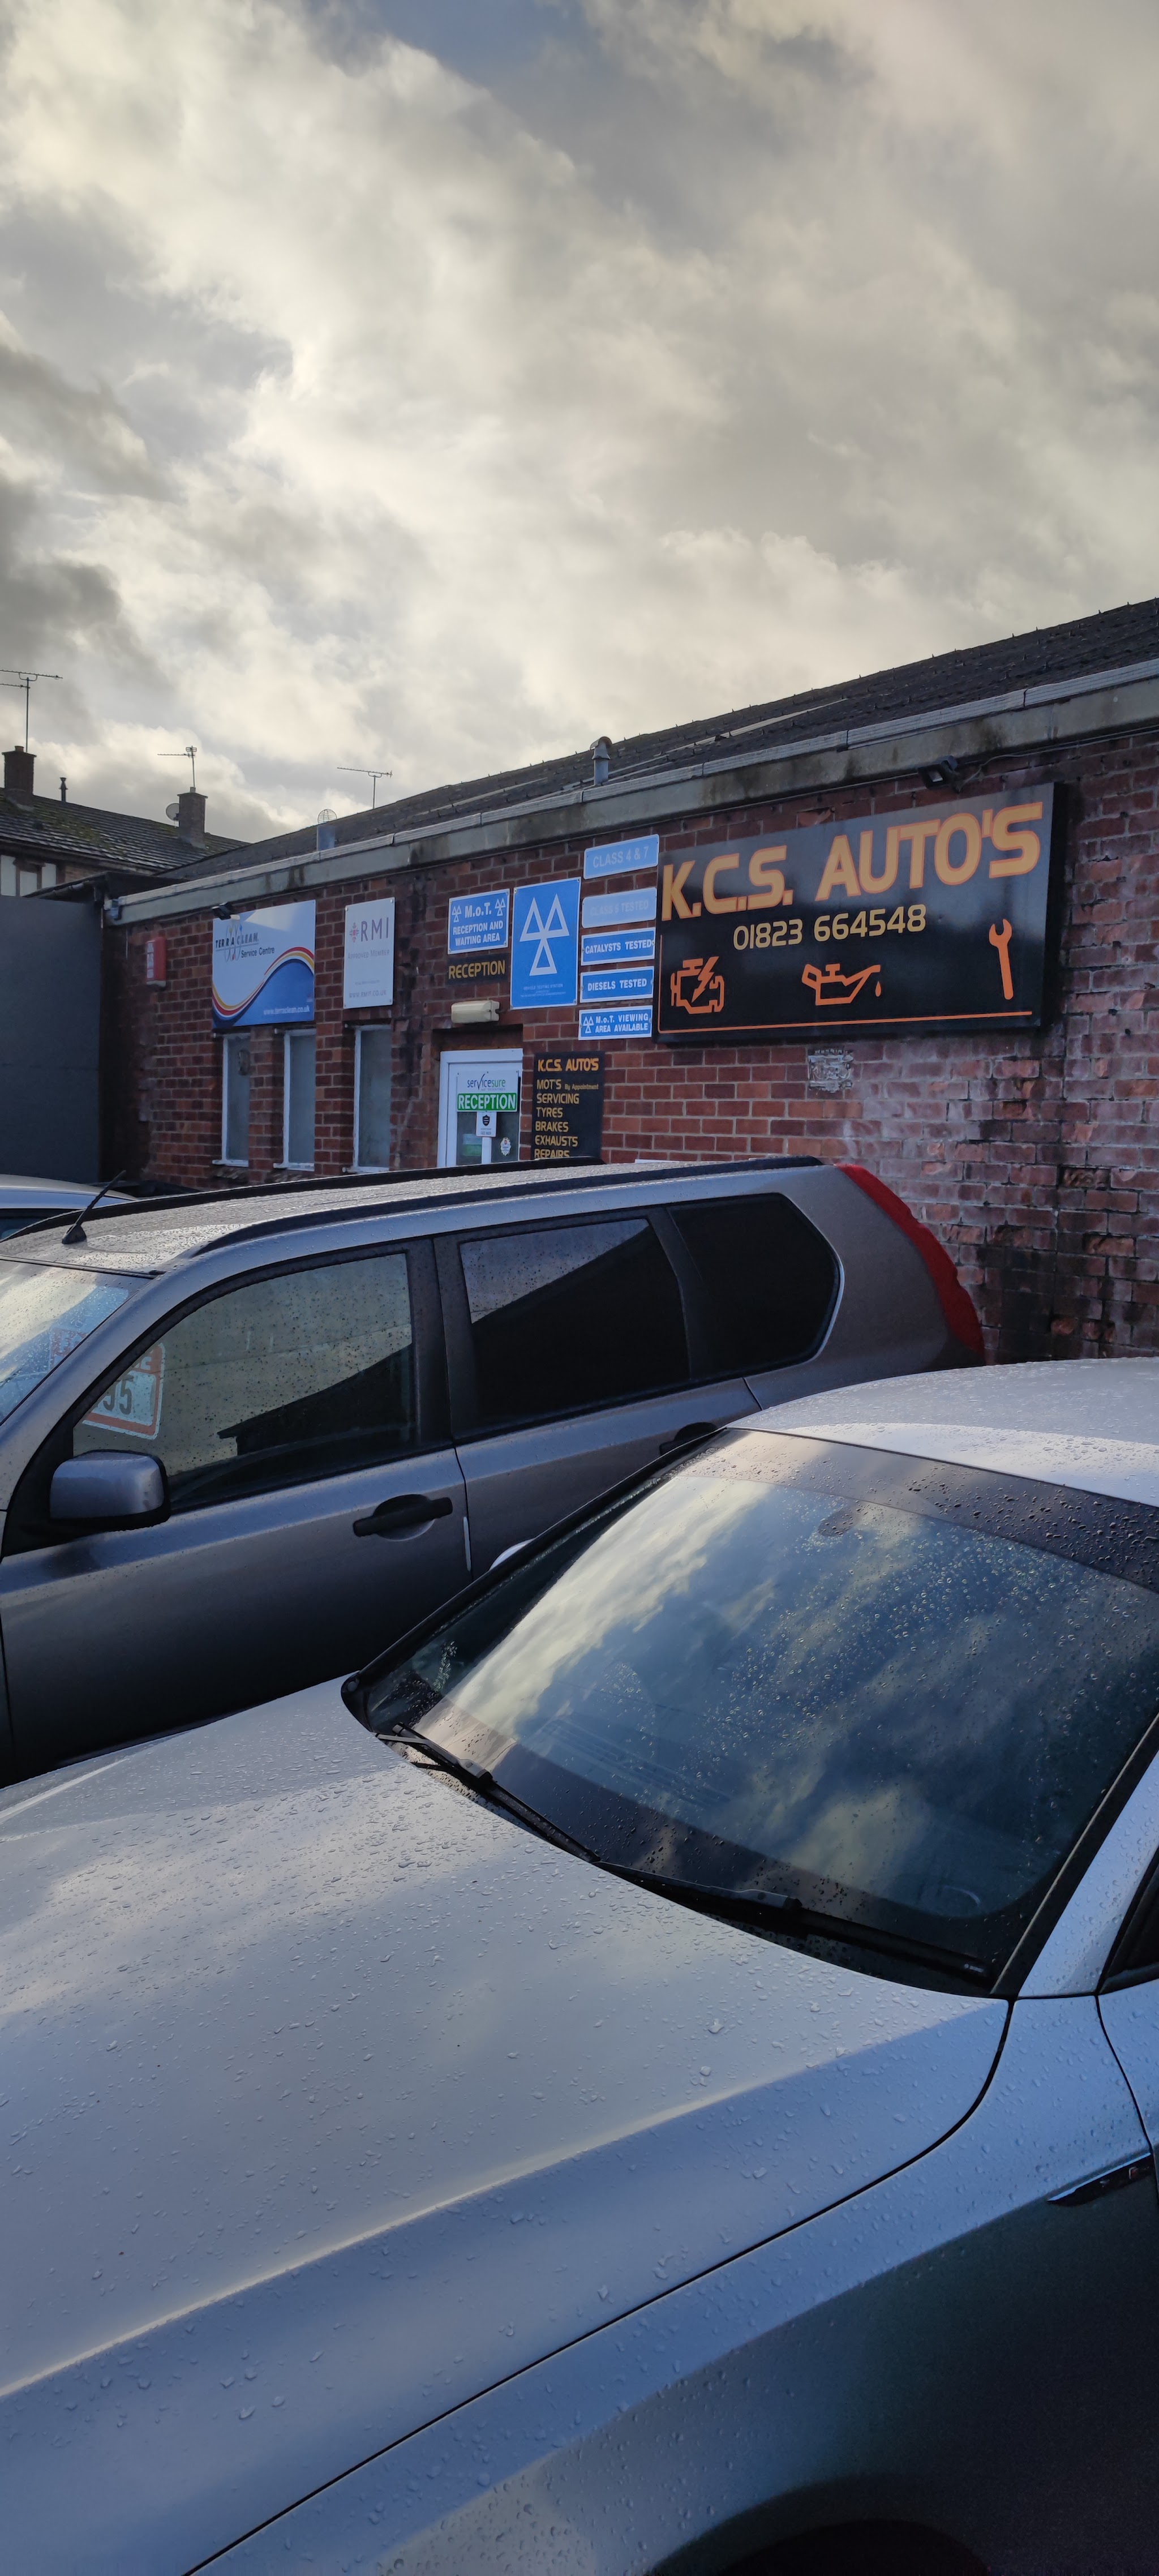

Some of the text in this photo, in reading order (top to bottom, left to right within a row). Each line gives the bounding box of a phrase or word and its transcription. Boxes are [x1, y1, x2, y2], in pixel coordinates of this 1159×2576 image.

[593, 846, 649, 868] CLASS 4 & 7
[662, 801, 1043, 921] K.C.S. AUTO'S
[465, 902, 491, 918] M.o.T.
[621, 899, 649, 912] TESTED
[360, 917, 389, 942] RMI
[453, 920, 503, 935] RECEPTION AND
[733, 904, 926, 950] 01823 664548
[455, 932, 500, 946] WAITING AREA
[241, 947, 274, 958] Service Centre
[585, 939, 651, 954] CATALYSTS TESTED
[449, 960, 505, 979] RECEPTION
[587, 979, 647, 991] DIESELS TESTED
[264, 1005, 310, 1015] www.terraclean.co.uk
[596, 1013, 649, 1024] M.o.T. VIEWING
[614, 1023, 648, 1032] AVAILABLE
[538, 1058, 599, 1071] K.C.S. AUTO'S
[537, 1079, 561, 1090] MOT'S
[458, 1094, 516, 1109] RECEPTION
[536, 1093, 580, 1104] SERVICING
[536, 1107, 563, 1118] TYRES
[535, 1121, 569, 1132] BRAKES
[535, 1135, 578, 1147] EXHAUSTS
[534, 1148, 570, 1159] REPAIRS
